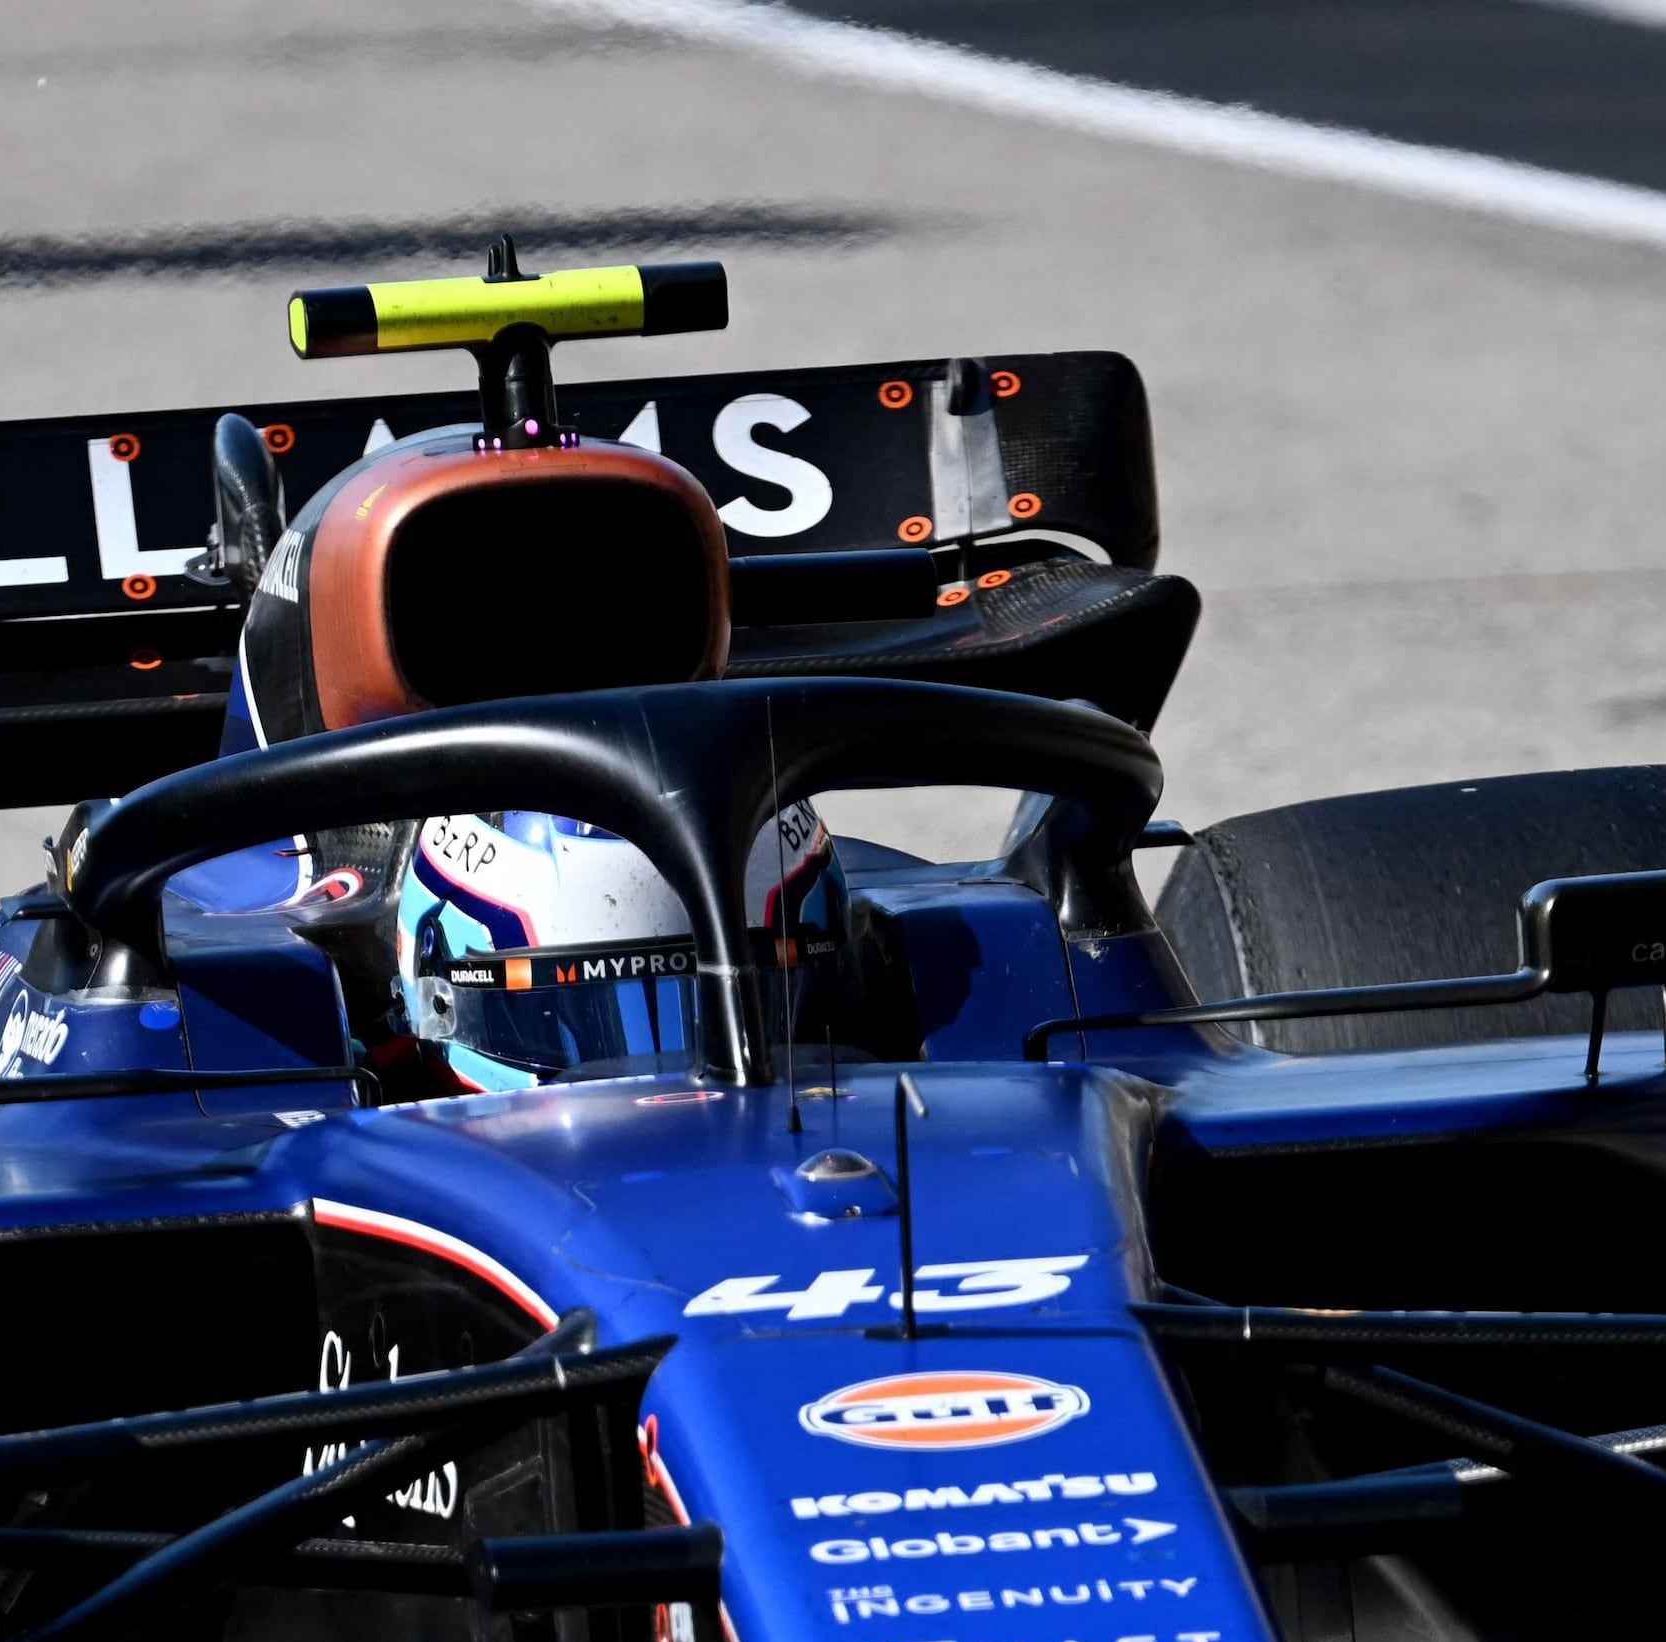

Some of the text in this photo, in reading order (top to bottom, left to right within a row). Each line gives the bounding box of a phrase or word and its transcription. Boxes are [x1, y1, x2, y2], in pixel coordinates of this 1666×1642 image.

[450, 967, 495, 984] DURACELL
[682, 1254, 1090, 1320] 43
[820, 1392, 1064, 1425] Gulf
[791, 1471, 1158, 1519] KOMATSU
[808, 1521, 1122, 1564] Globant
